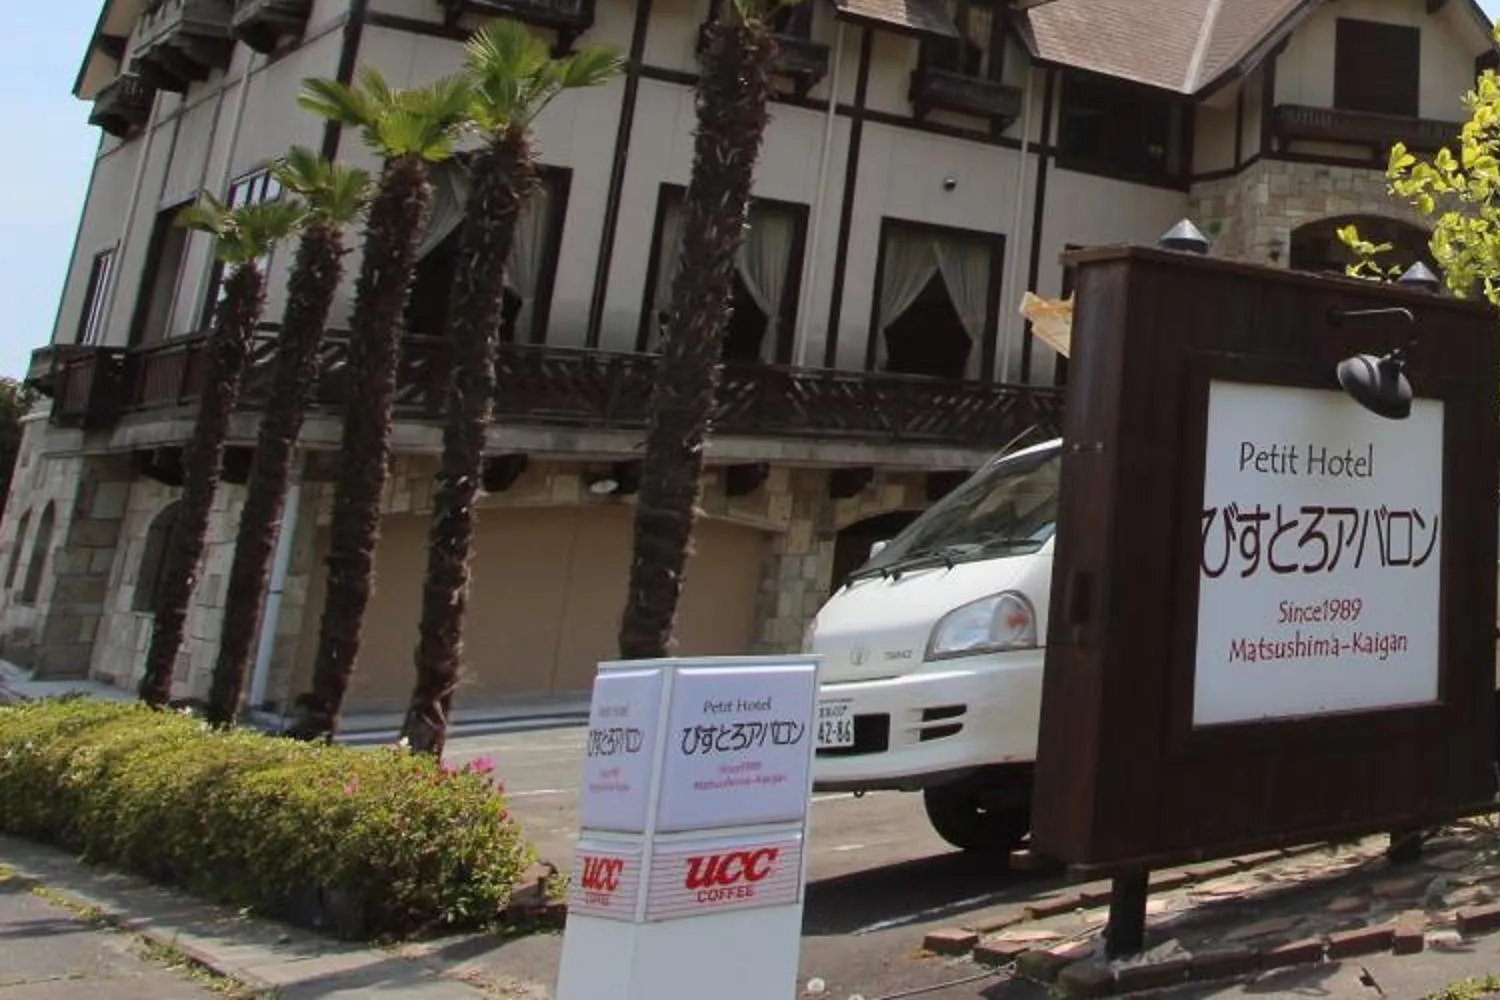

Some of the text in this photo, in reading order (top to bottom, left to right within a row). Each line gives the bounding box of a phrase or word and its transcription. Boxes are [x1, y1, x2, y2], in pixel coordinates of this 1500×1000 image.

[1239, 441, 1374, 478] Petit Hotel
[1199, 502, 1439, 579] びすとろアバロン
[1278, 598, 1363, 624] Since1989
[1229, 630, 1408, 663] Matsushima-Kaigan
[703, 696, 772, 713] Petit Hotel
[581, 856, 625, 892] UCC
[685, 848, 780, 890] UCC
[697, 885, 754, 903] COFFEE
